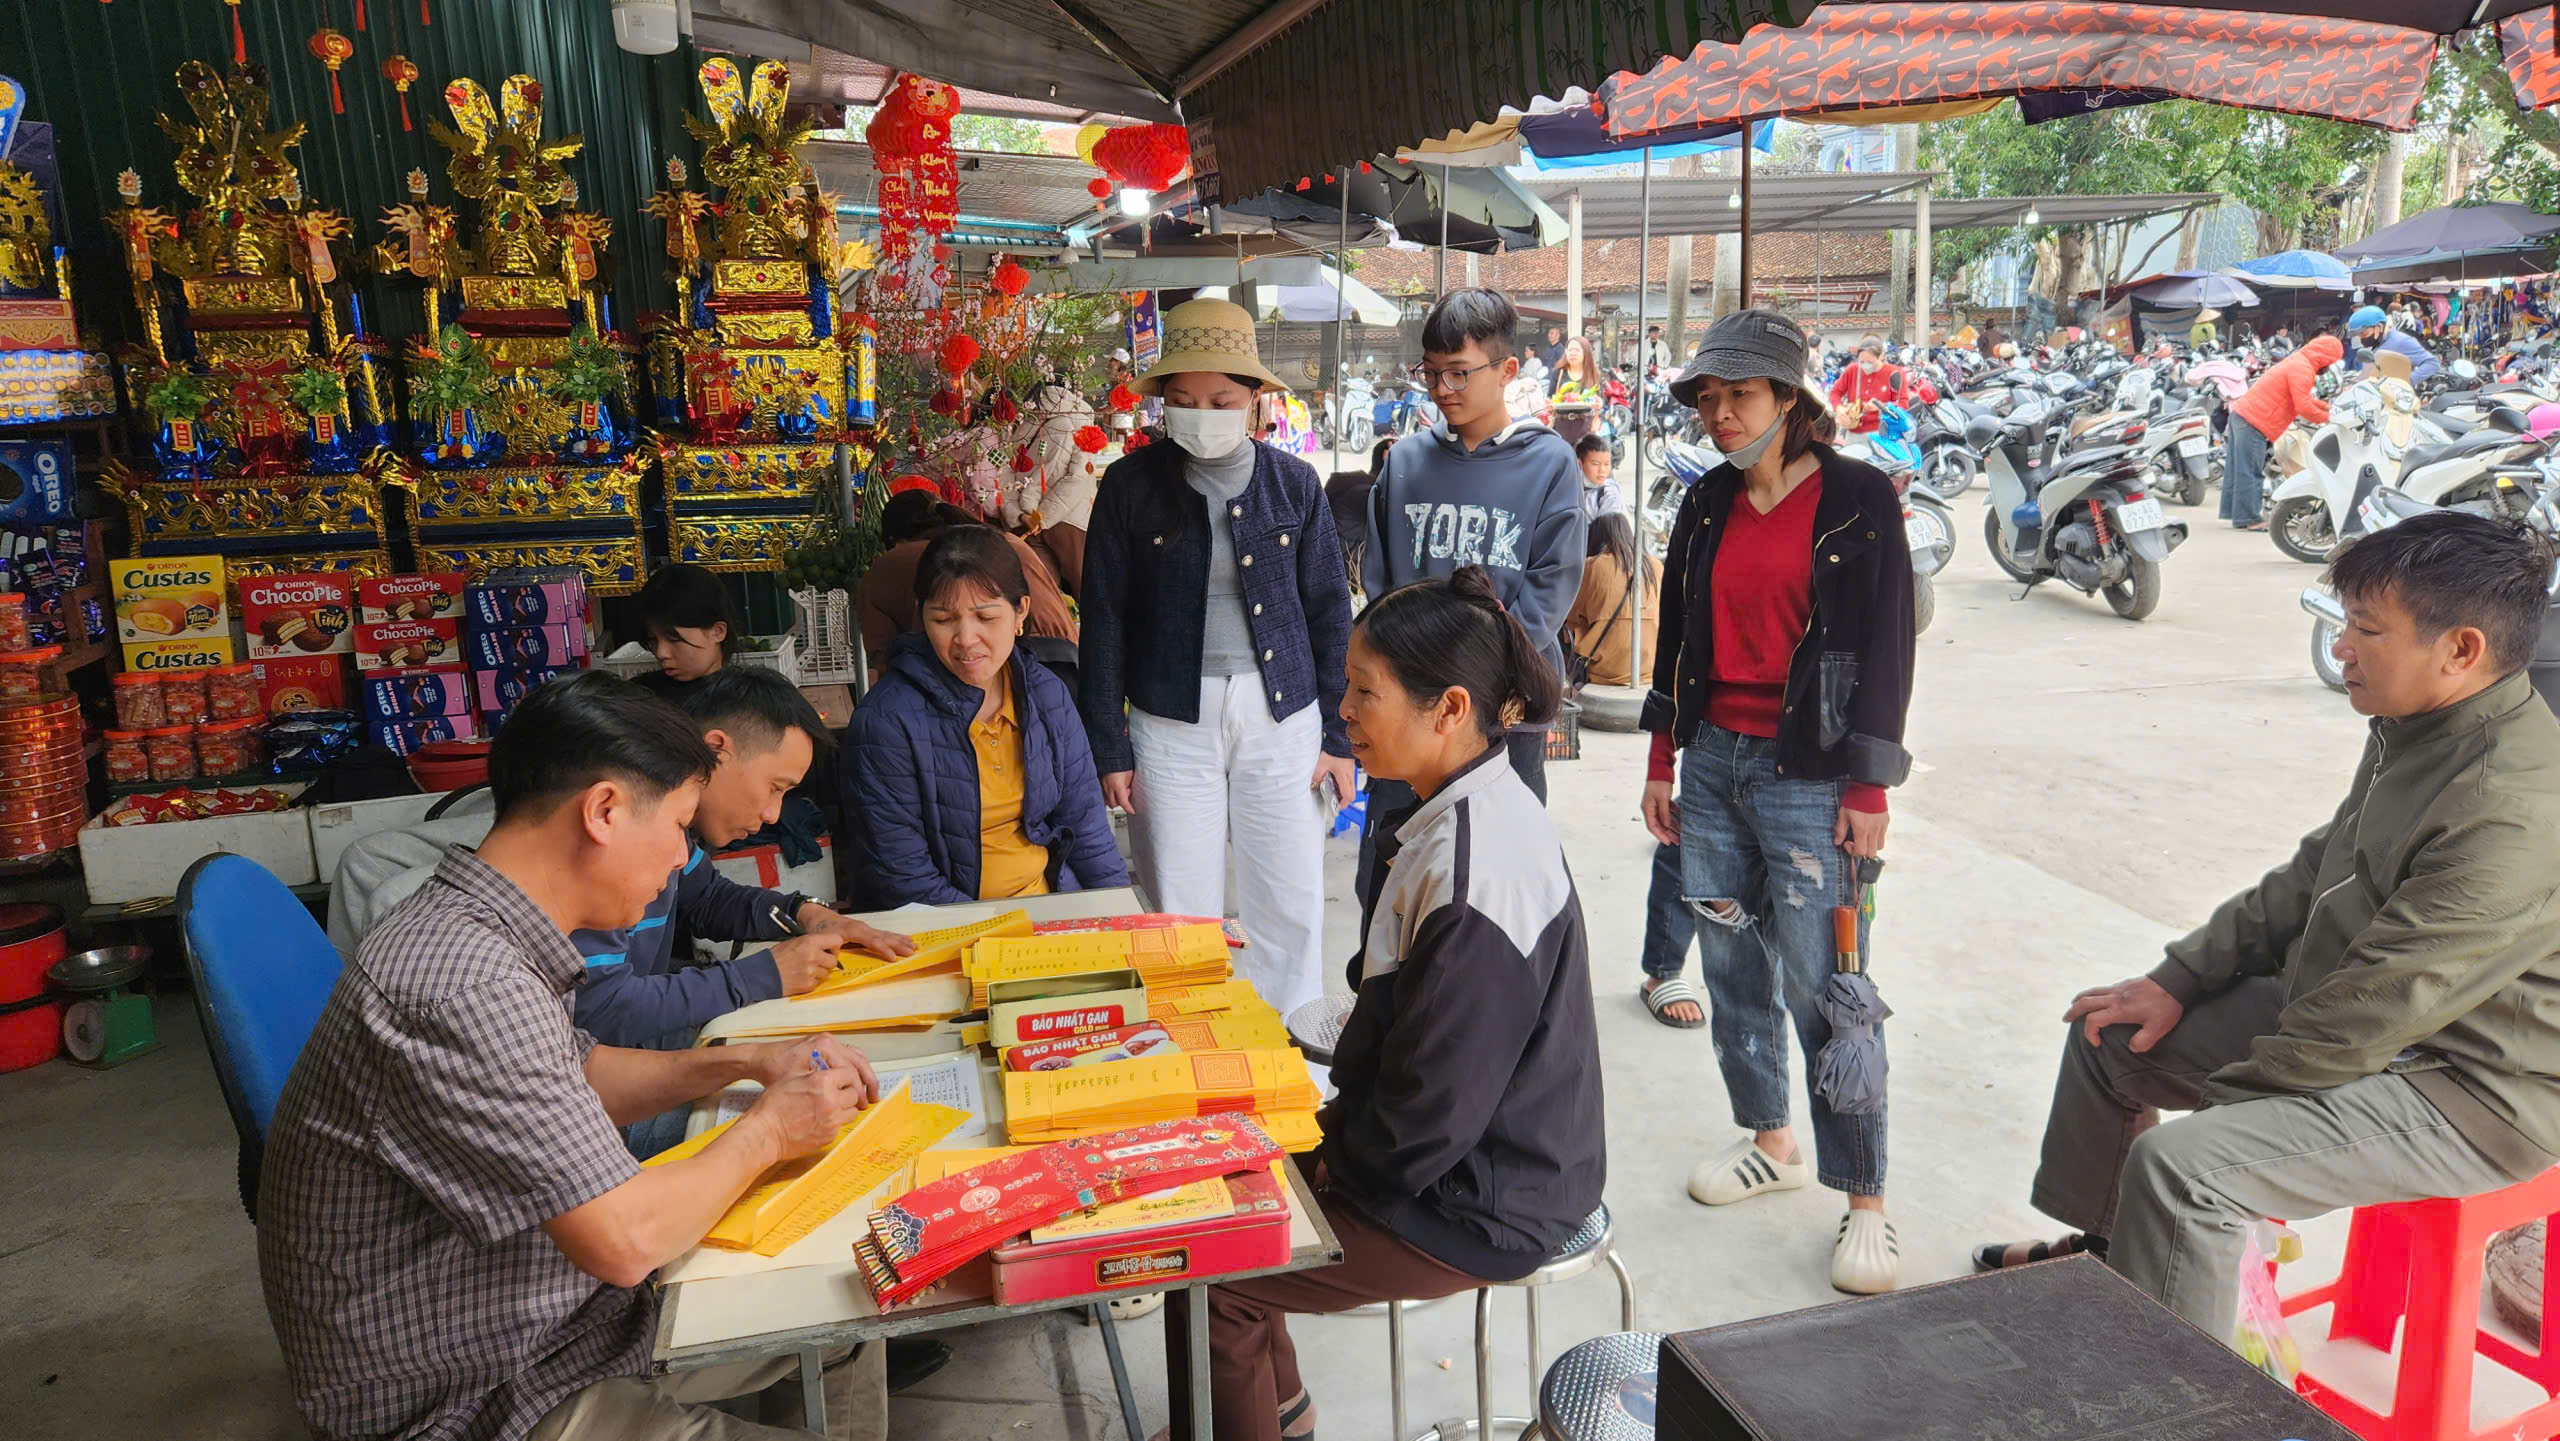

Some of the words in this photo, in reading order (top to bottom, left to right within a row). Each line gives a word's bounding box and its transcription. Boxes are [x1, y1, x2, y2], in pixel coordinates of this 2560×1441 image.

[37, 453, 60, 513] OREO
[1404, 503, 1522, 571] YORK
[123, 570, 211, 589] Custas
[282, 581, 316, 589] ORION
[379, 581, 441, 595] ChocoPie
[250, 586, 342, 606] ChocoPie
[477, 591, 495, 624] OREO
[373, 626, 435, 640] ChocoPie
[480, 633, 496, 666] OREO
[135, 651, 222, 670] Custas
[375, 682, 392, 716] OREO
[1032, 1014, 1053, 1032] BẢO
[1056, 1011, 1085, 1028] NHẤT
[1087, 1010, 1109, 1025] GAN
[1074, 1025, 1094, 1035] GOLD
[1022, 1043, 1049, 1057] BẢO
[1053, 1036, 1088, 1051] NHẤT
[1091, 1031, 1118, 1043] GAN
[1075, 1043, 1100, 1053] GOLD
